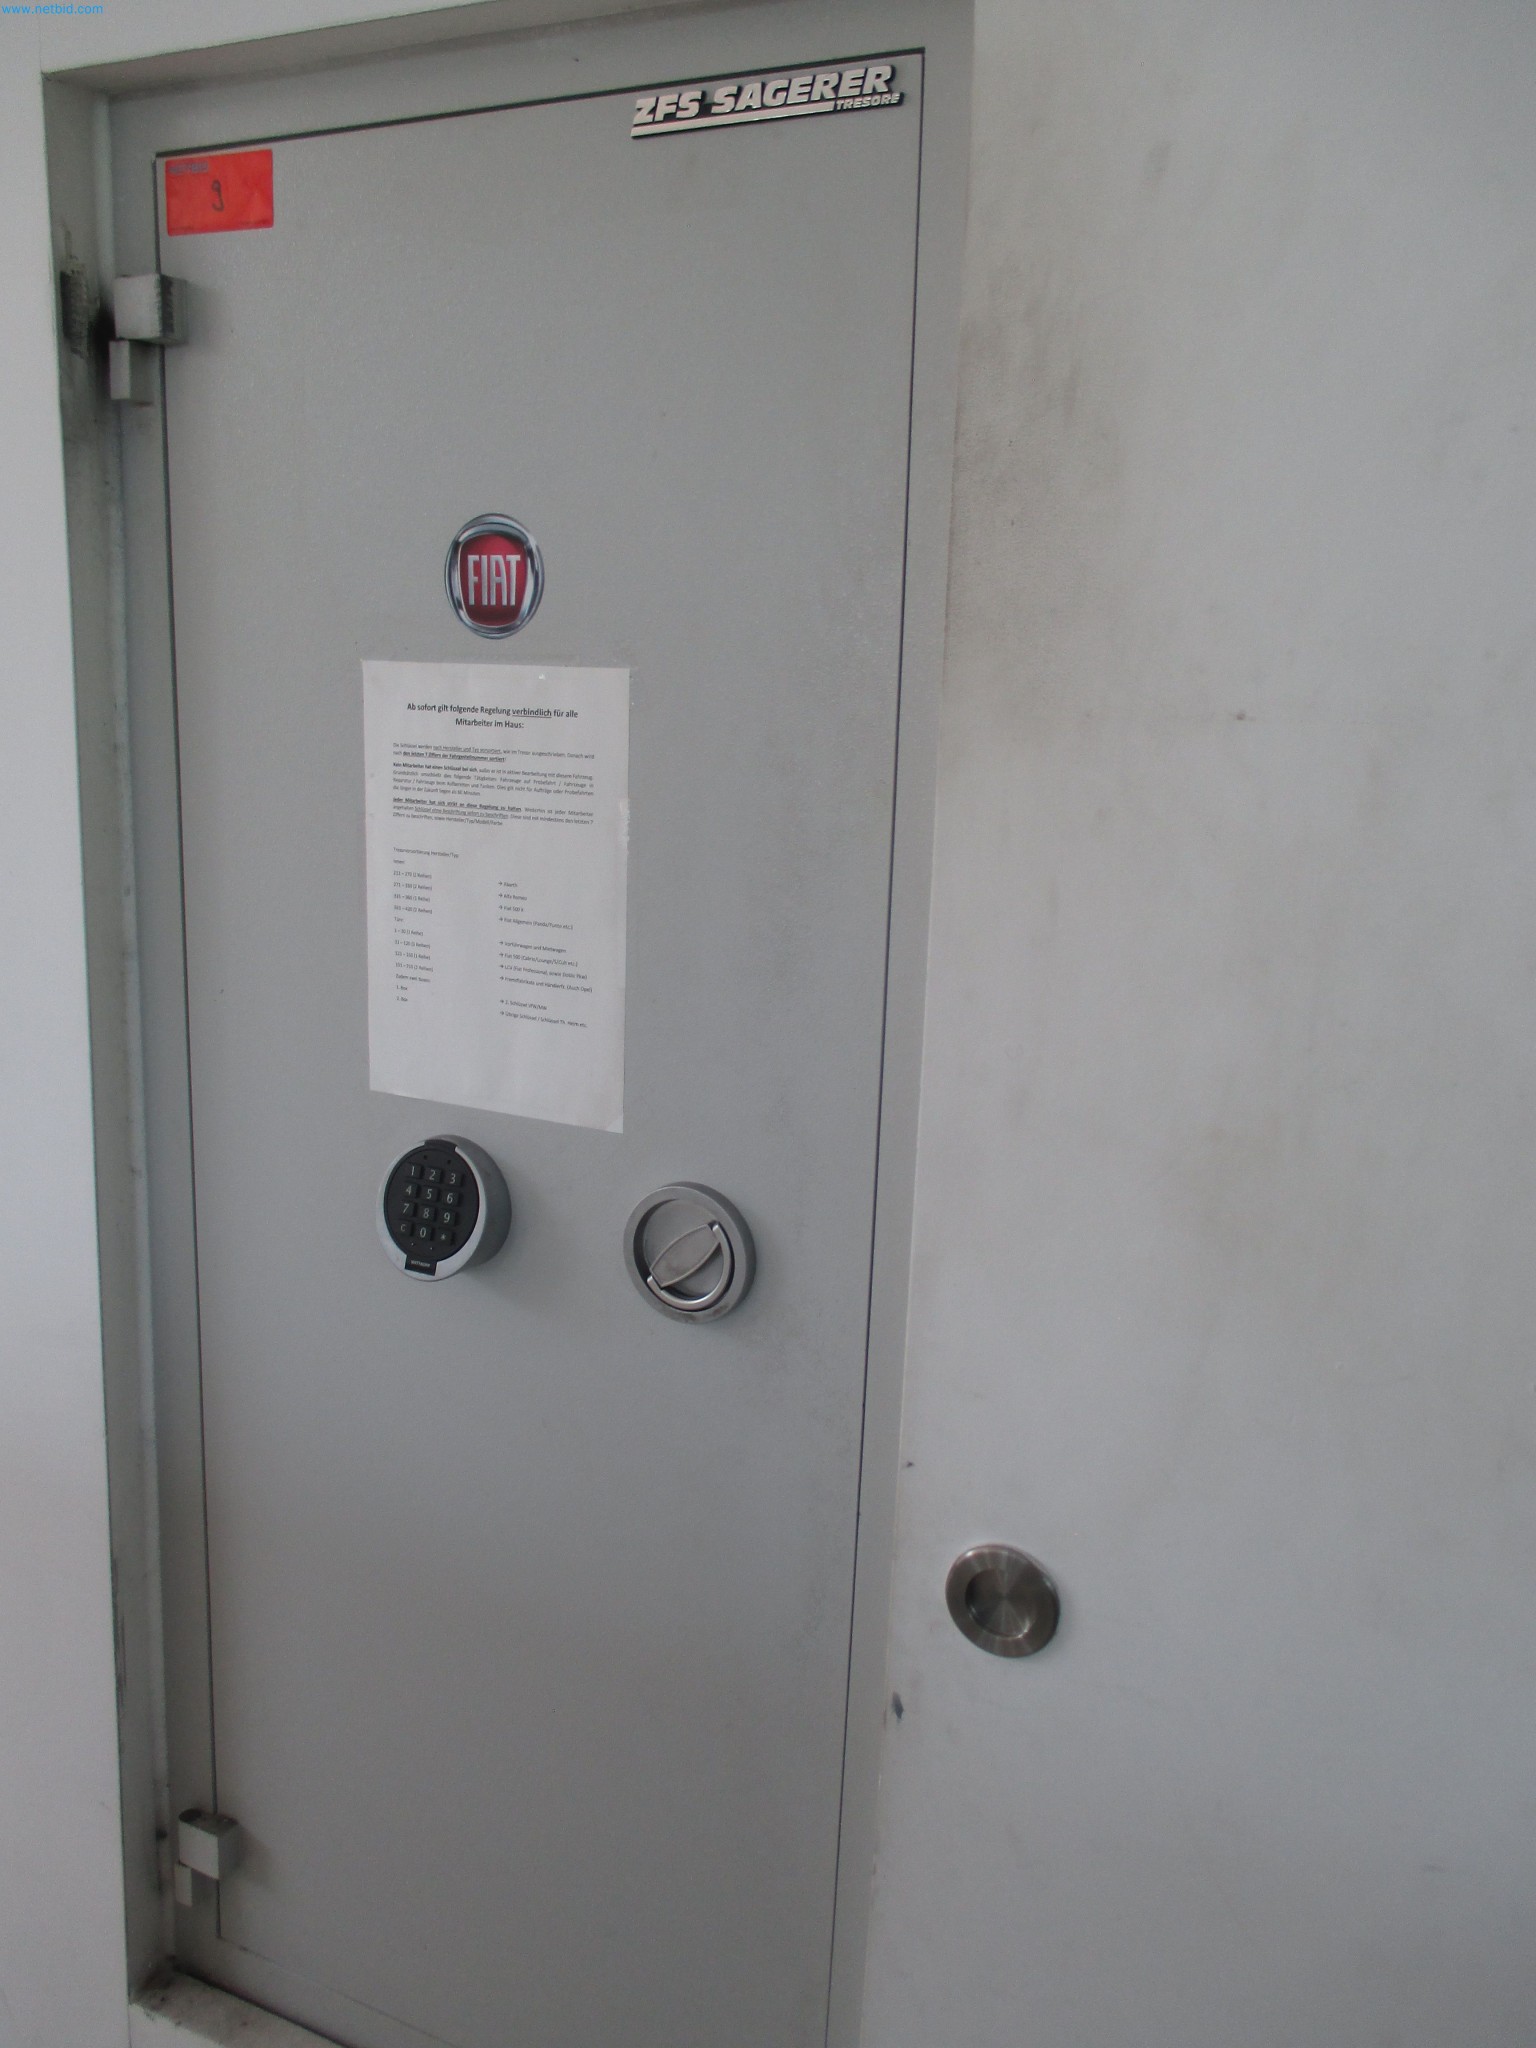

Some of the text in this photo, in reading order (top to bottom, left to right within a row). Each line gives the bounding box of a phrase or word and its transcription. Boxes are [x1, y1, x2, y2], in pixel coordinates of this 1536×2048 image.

[633, 65, 893, 125] ZFS SAGERER
[836, 92, 901, 111] TRESORE
[467, 554, 521, 606] FIAT
[438, 704, 448, 713] gilt
[450, 705, 479, 714] folgende
[481, 707, 511, 716] Regelung
[512, 708, 552, 716] verbindlich
[566, 710, 578, 718] alle
[456, 718, 493, 727] Mitarbeiter
[505, 721, 524, 729] Haus:
[411, 1166, 456, 1184] 1 2 3
[406, 1185, 453, 1204] 4 5 6
[402, 1203, 450, 1223] 7 8 9
[420, 1228, 426, 1238] 0
